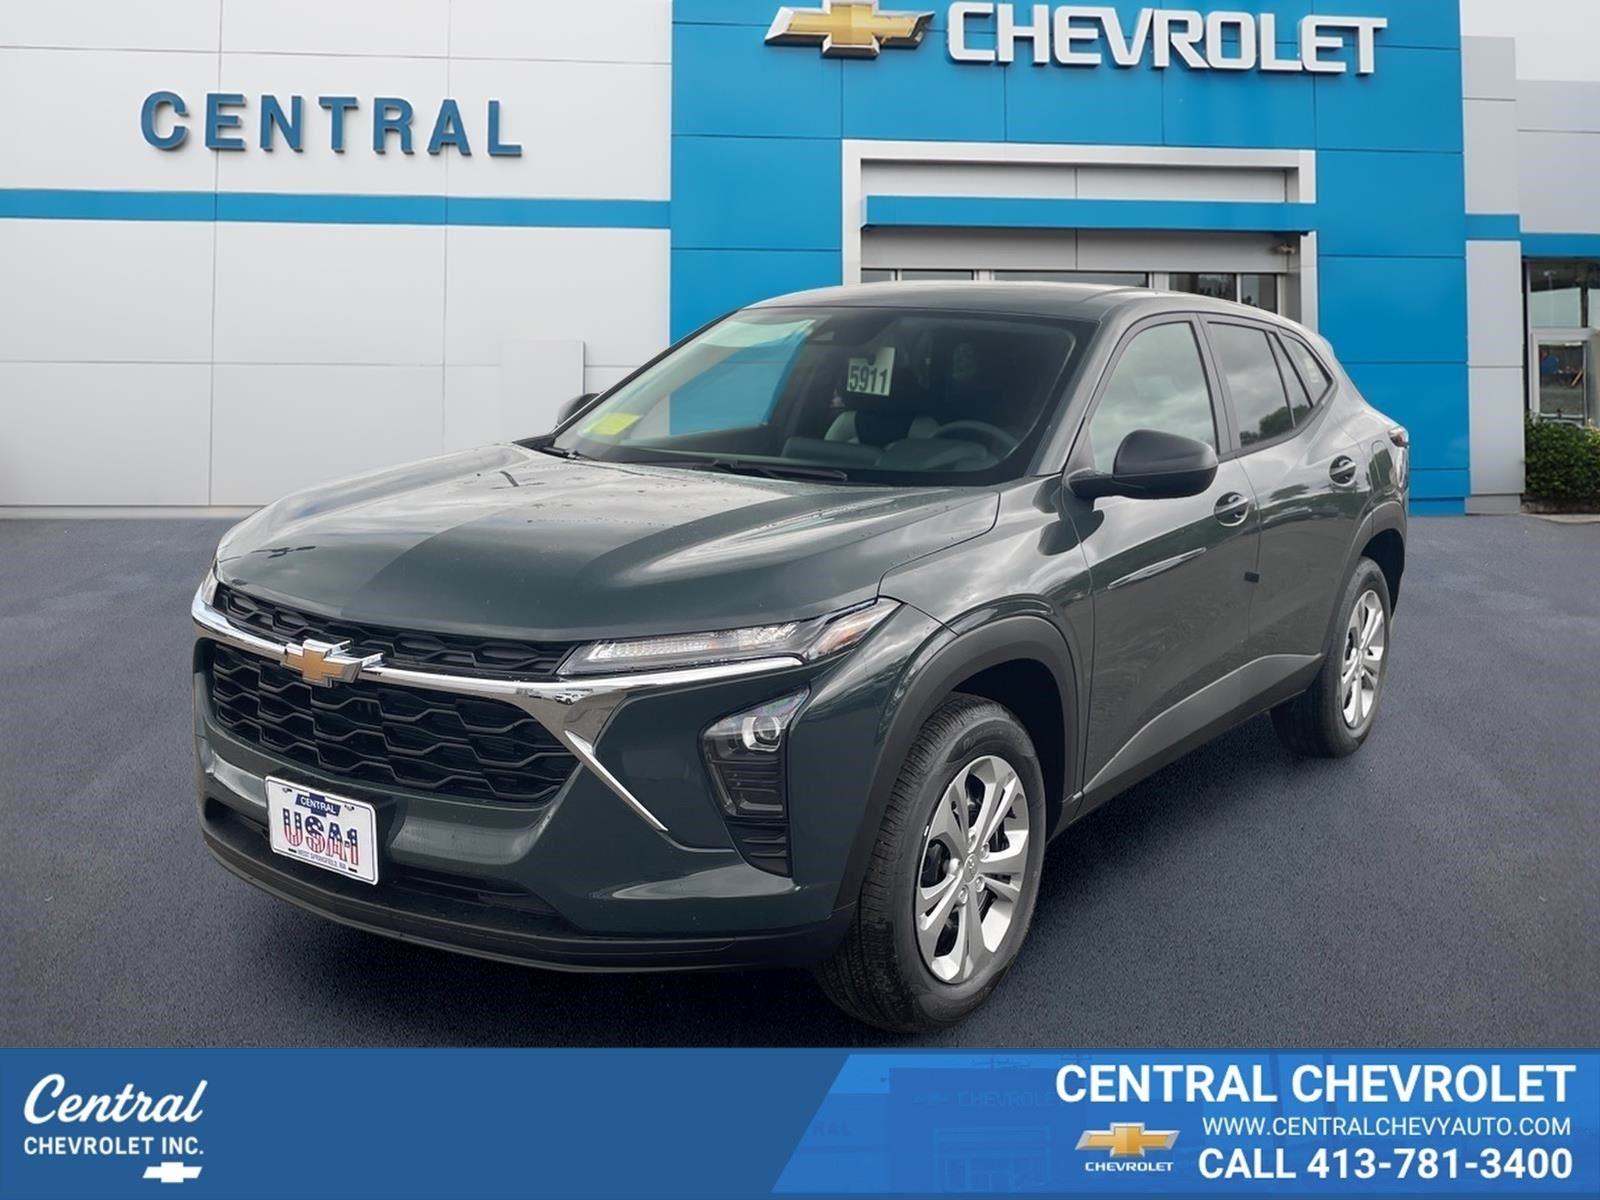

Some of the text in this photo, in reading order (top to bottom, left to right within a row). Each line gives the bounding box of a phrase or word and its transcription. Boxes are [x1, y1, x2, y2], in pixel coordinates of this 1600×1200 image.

[947, 0, 1388, 75] CHEVROLET
[140, 90, 523, 157] CENTRAL
[849, 364, 889, 394] 5911
[300, 796, 337, 814] CENTRAL
